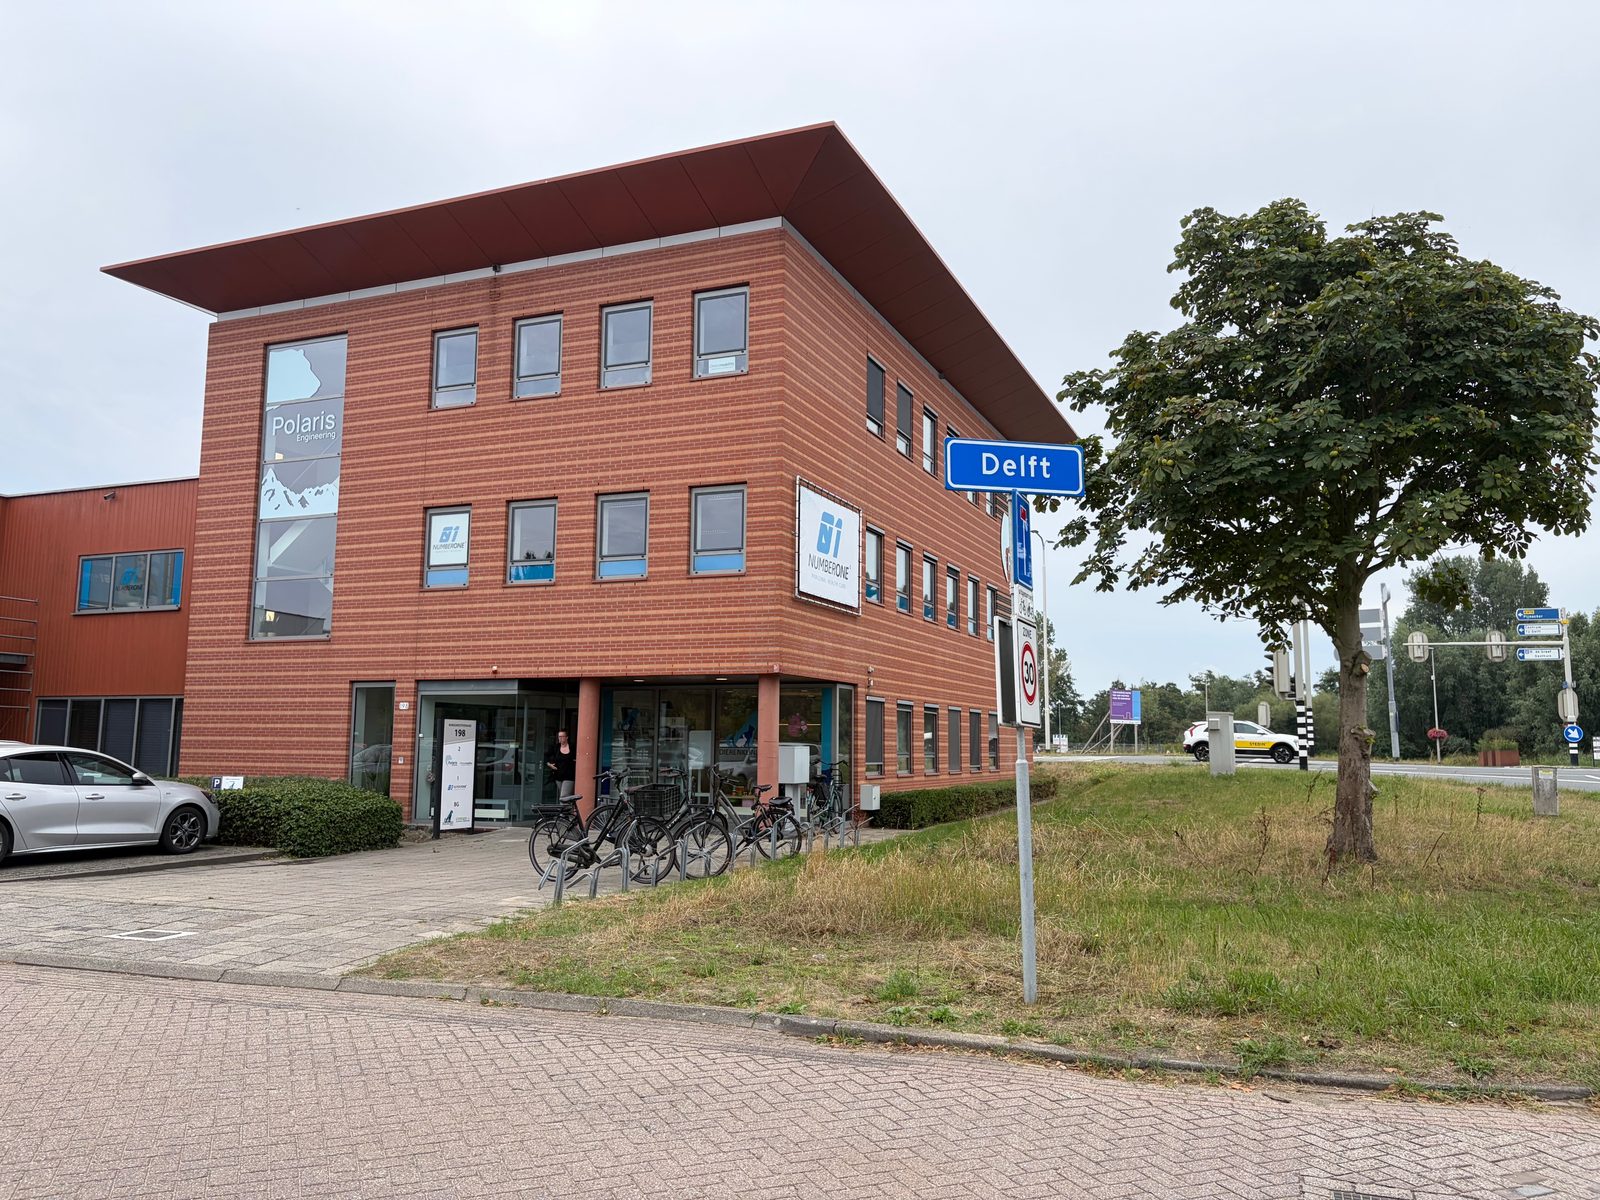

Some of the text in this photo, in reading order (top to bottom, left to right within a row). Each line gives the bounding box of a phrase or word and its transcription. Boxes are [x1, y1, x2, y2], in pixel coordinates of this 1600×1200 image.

[272, 410, 336, 436] Polaris
[296, 431, 336, 443] Engineering
[982, 452, 1051, 479] Delft
[1022, 626, 1032, 640] ZONE
[1024, 661, 1034, 685] 30
[454, 729, 466, 737] 198
[213, 779, 221, 788] P
